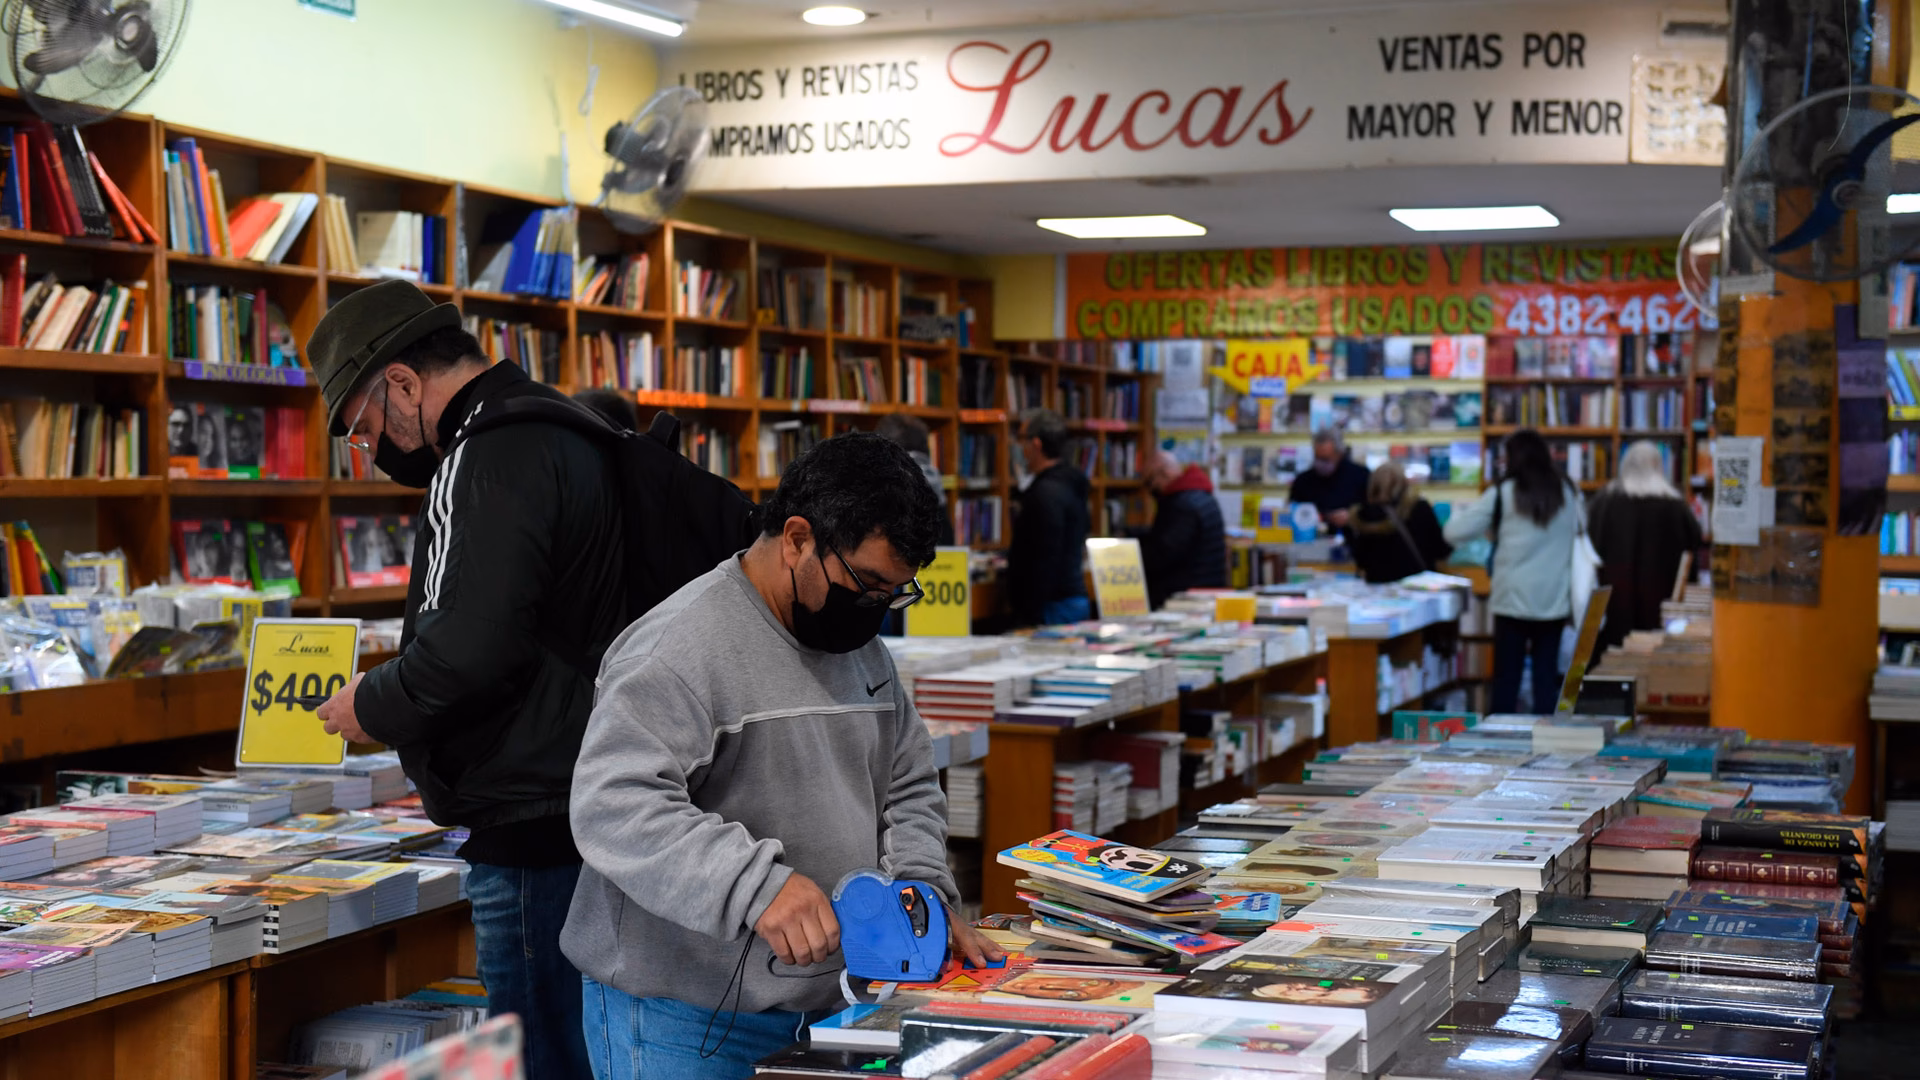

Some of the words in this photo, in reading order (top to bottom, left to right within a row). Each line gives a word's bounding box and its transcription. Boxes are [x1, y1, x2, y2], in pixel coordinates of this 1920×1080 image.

[1379, 33, 1502, 72] VENTAS
[1522, 32, 1586, 69] POR
[775, 68, 790, 99] Y
[801, 61, 919, 98] REVISTAS
[938, 39, 1313, 158] Lucas
[1347, 101, 1456, 141] MAYOR
[1473, 100, 1493, 136] Y
[1511, 100, 1623, 136] MENOR
[709, 123, 814, 157] MPRAMOS
[824, 118, 911, 152] USADOS
[1106, 250, 1275, 290] OFERTAS
[1286, 247, 1431, 287] LIBROS
[1439, 245, 1467, 285] Y
[1481, 247, 1678, 283] REVISTAS
[1077, 299, 1318, 338] COMPRAMOS
[1331, 294, 1494, 335] USADOS
[1506, 294, 1608, 335] 4382
[1232, 352, 1303, 379] CAJA
[912, 580, 967, 608] 300
[278, 632, 330, 653] Lucas
[1780, 831, 1822, 840] GIGANTES
[1797, 839, 1827, 848] DANZA
[1823, 833, 1840, 841] LOS
[1828, 841, 1840, 849] LA
